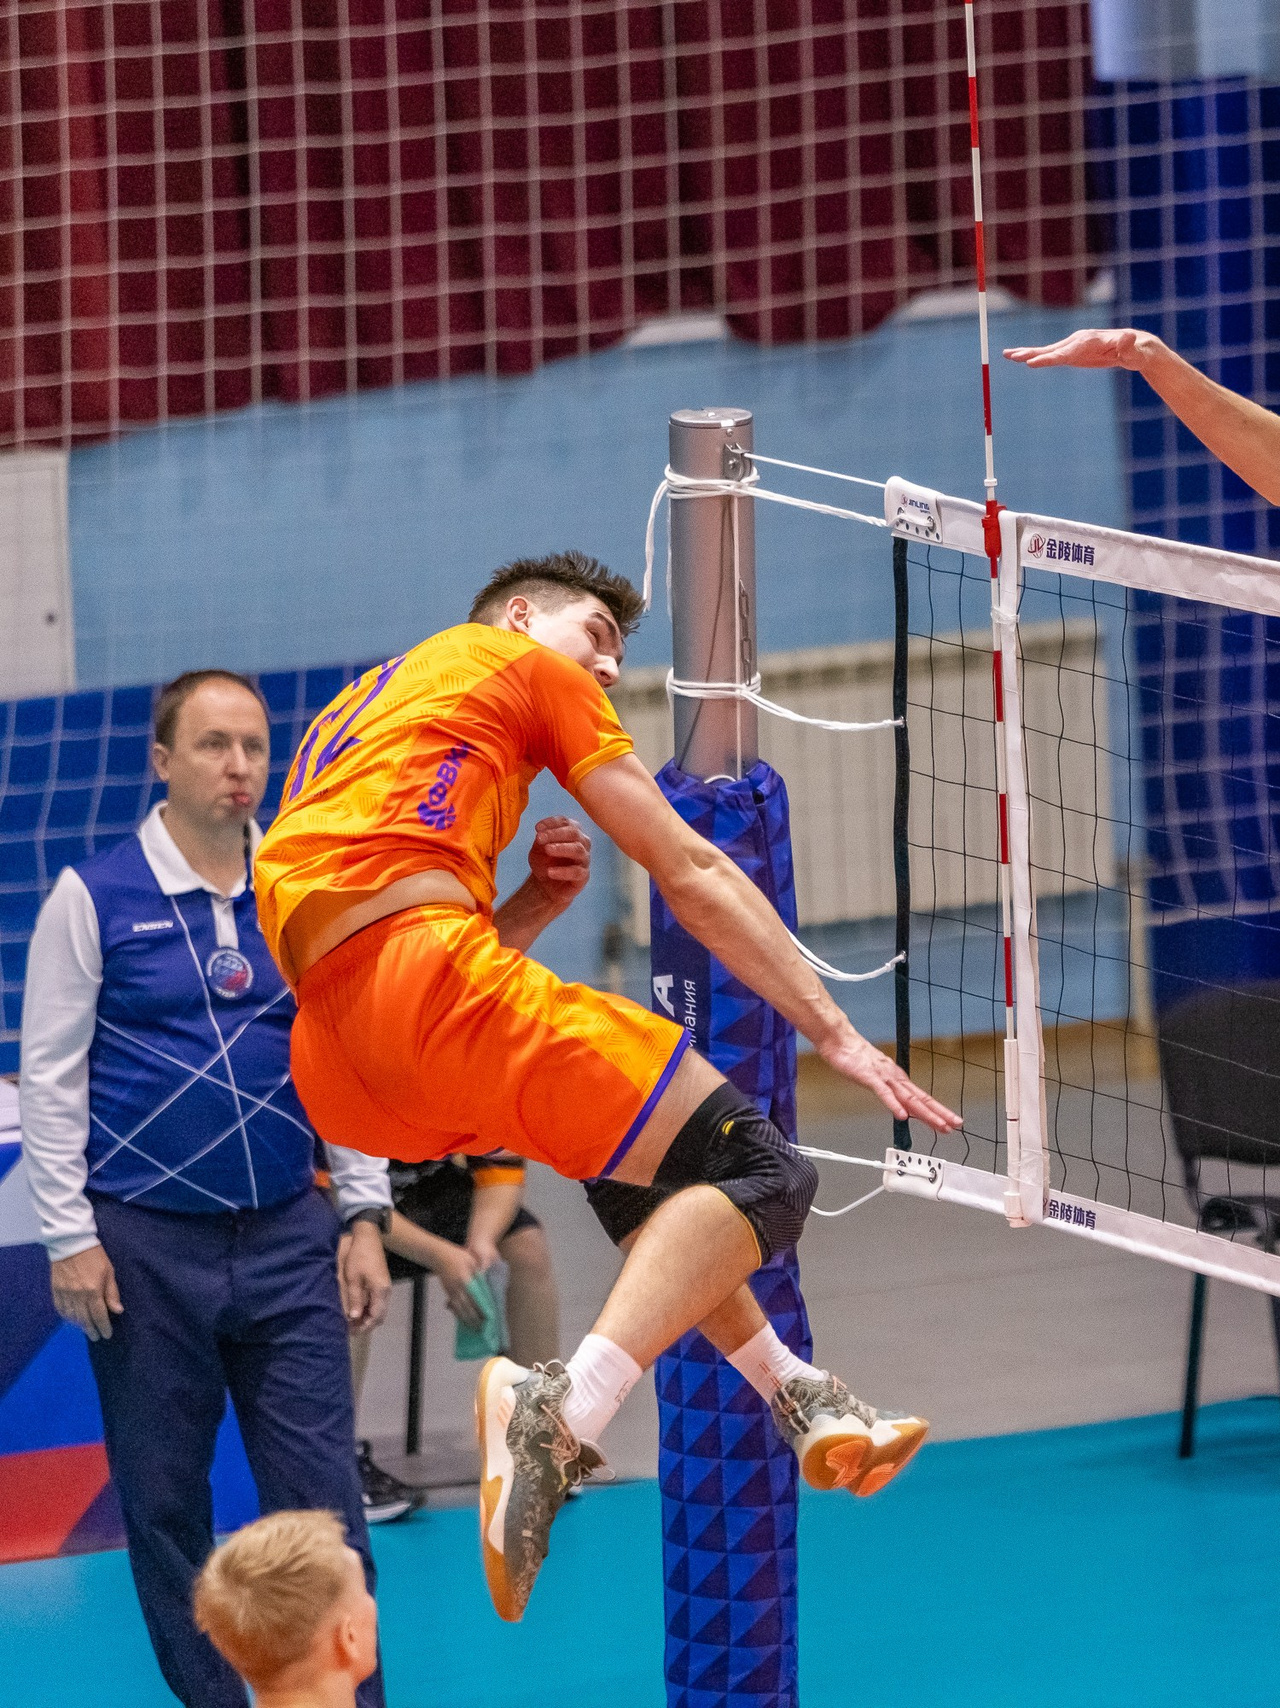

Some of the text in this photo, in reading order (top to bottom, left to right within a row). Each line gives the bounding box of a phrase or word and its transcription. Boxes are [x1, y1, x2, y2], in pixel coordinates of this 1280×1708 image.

[1046, 538, 1096, 566] 金陵体育
[1049, 1200, 1097, 1231] 金陵体育
